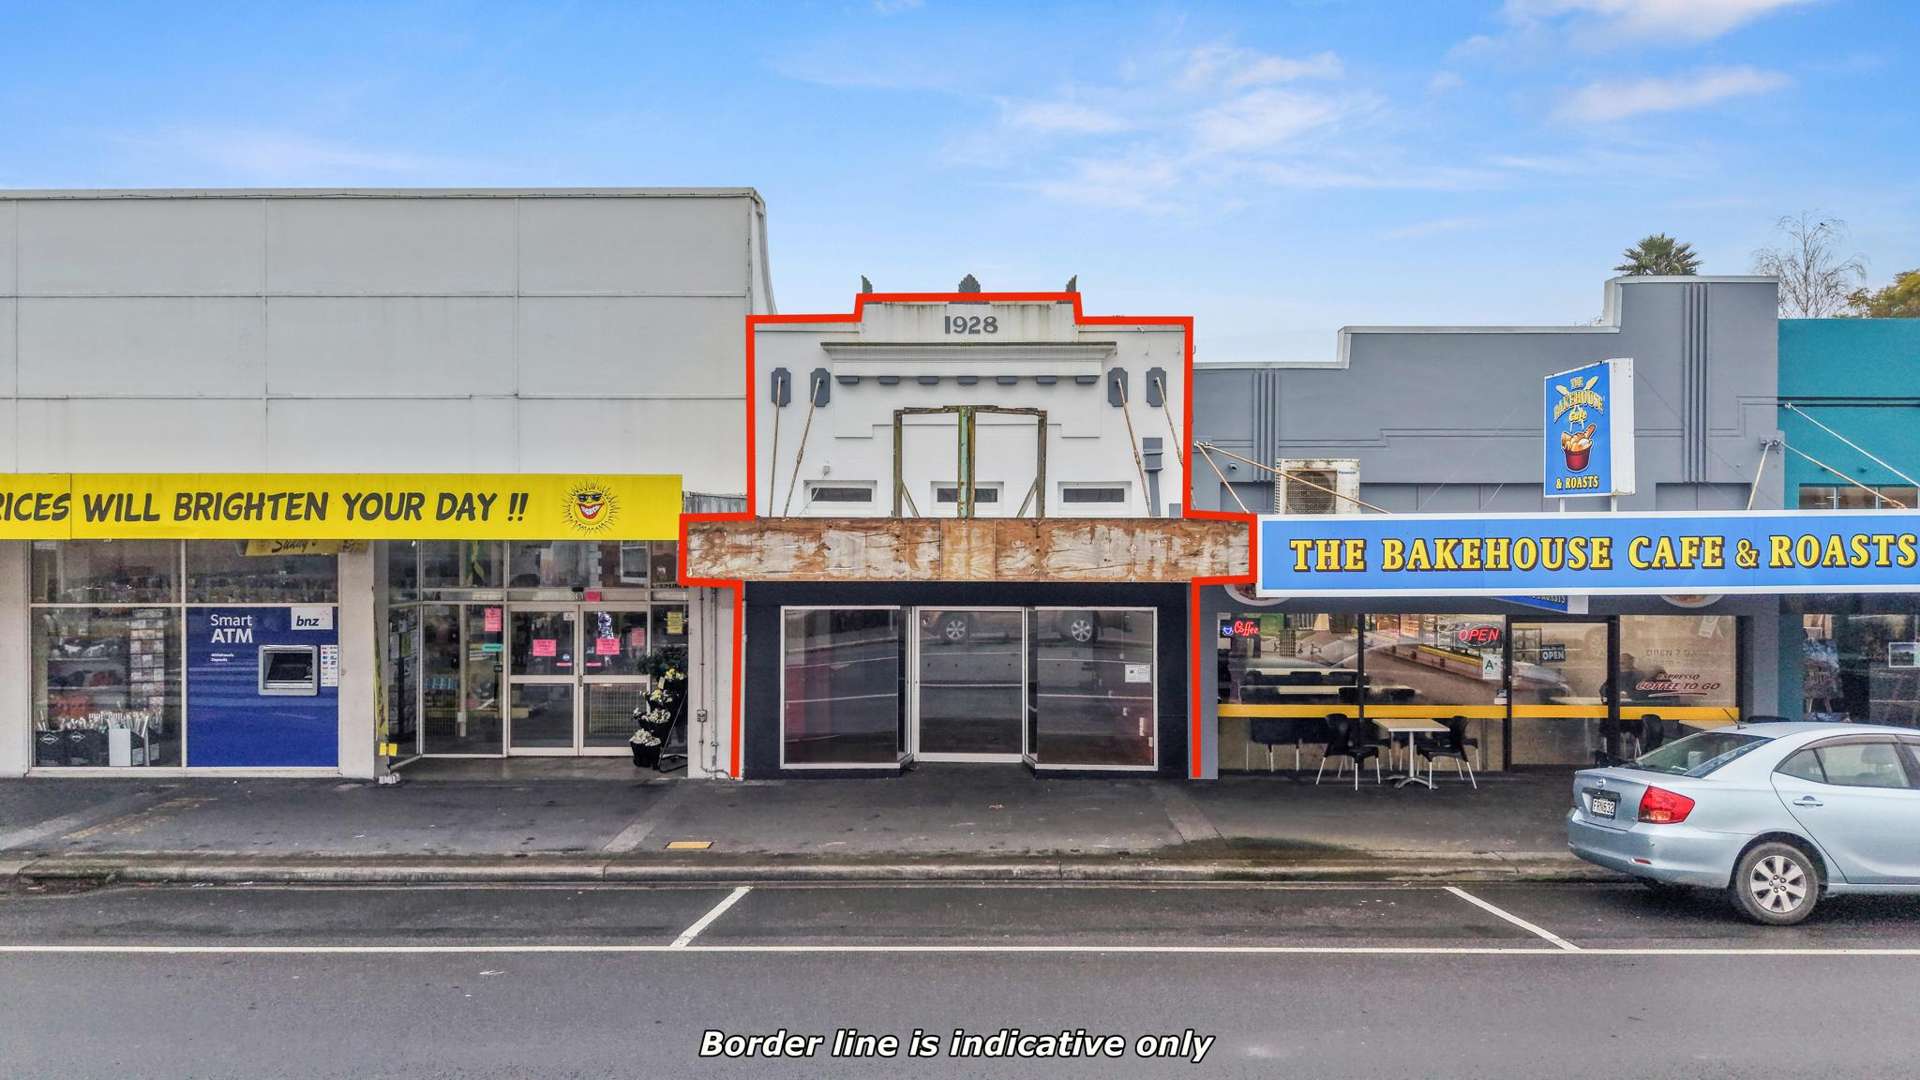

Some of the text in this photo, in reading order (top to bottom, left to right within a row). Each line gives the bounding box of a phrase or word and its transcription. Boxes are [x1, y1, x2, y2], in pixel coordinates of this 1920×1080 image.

[944, 315, 999, 335] 1928
[1565, 475, 1600, 489] ROASTS
[0, 491, 529, 522] ICES WILL BRIGHTEN YOUR DAY !!
[1289, 533, 1919, 572] THE BAKEHOUSE CAFE & ROASTS
[210, 614, 253, 626] Smart
[295, 615, 320, 627] bnz
[1234, 620, 1259, 637] Coffee
[1458, 628, 1500, 641] OPEN
[210, 628, 254, 644] ATM
[1542, 651, 1565, 661] OPEN
[1683, 682, 1699, 690] TO
[1701, 682, 1721, 690] GO
